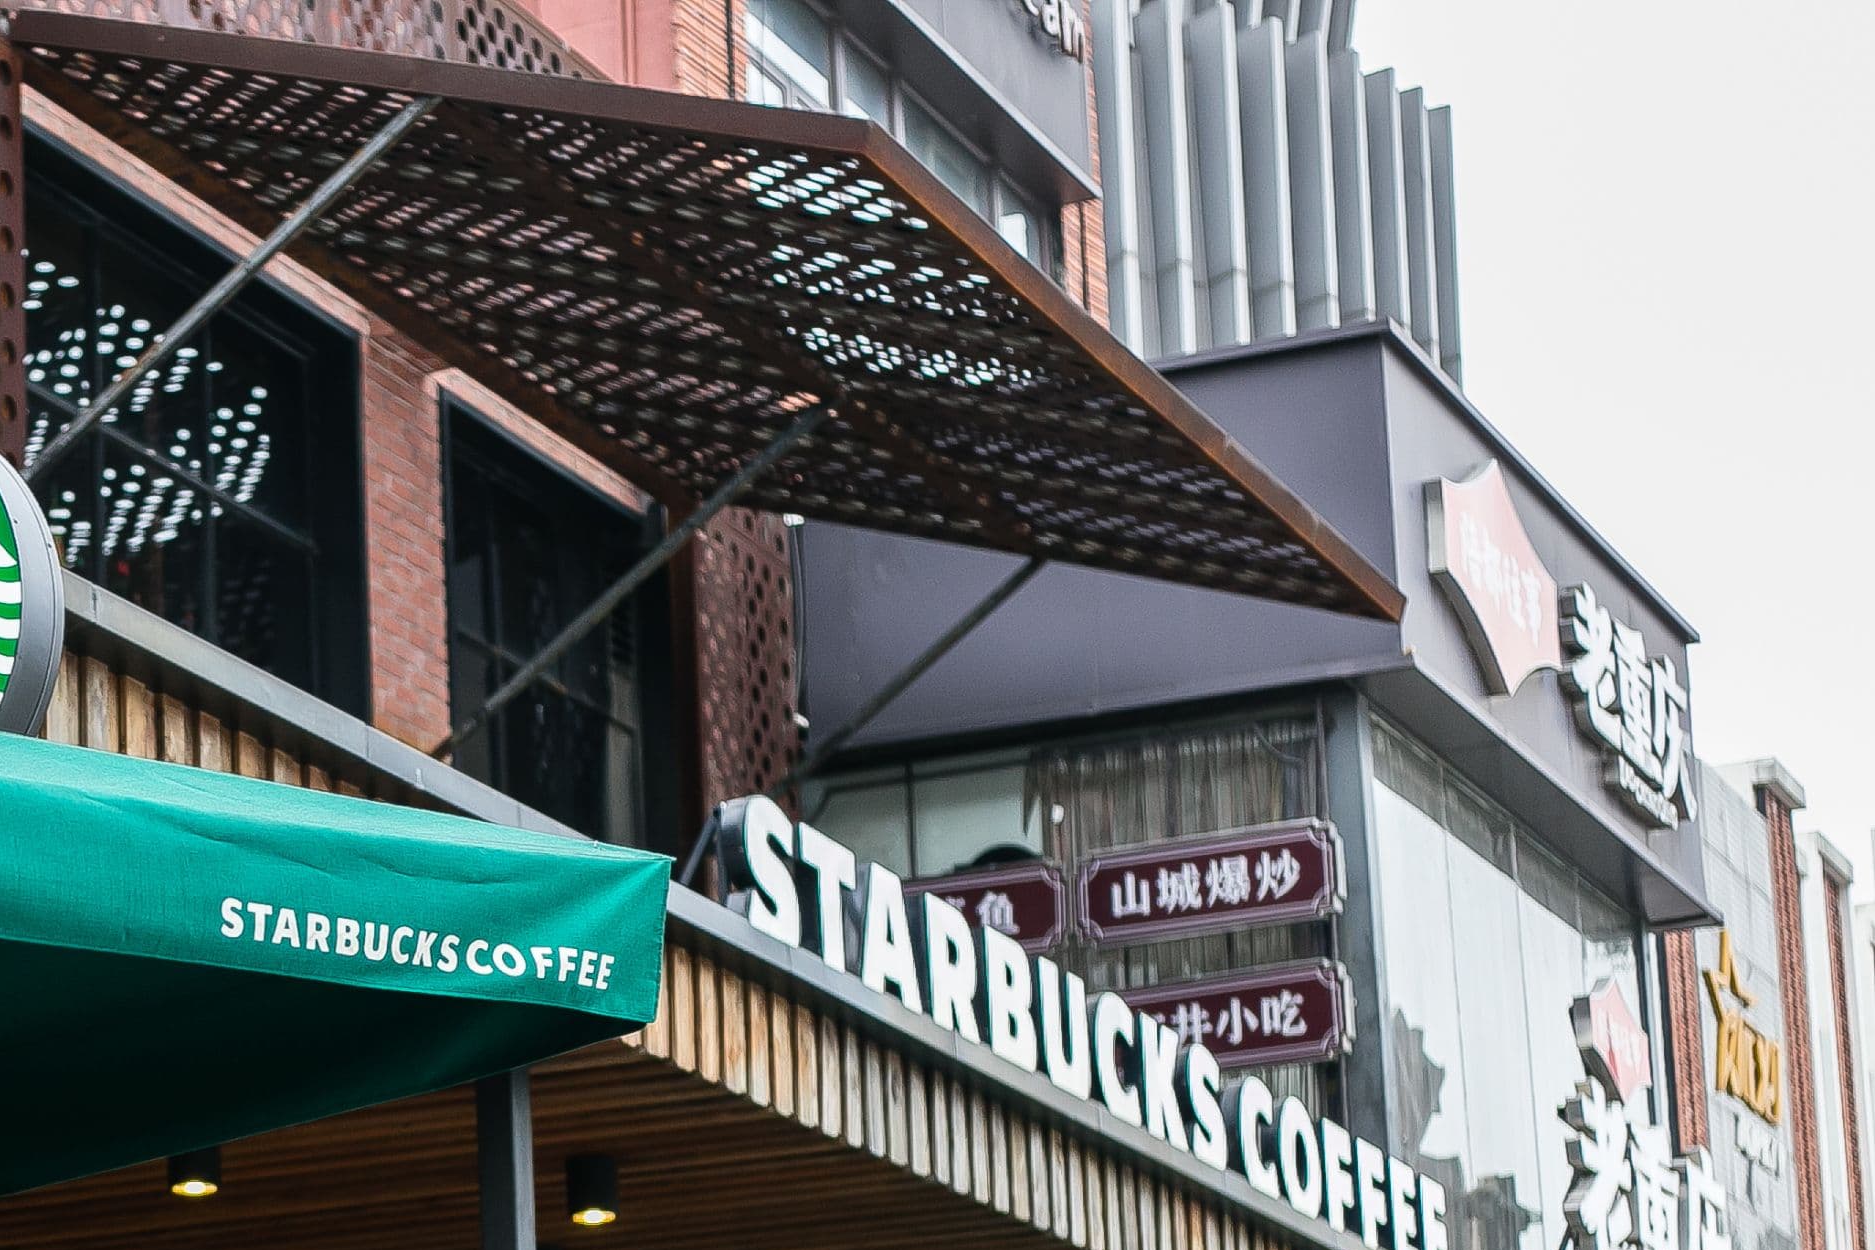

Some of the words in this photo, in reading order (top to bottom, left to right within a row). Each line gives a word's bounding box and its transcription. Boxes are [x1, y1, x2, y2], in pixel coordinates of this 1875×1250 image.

[1109, 847, 1302, 920] 山城爆炒
[220, 896, 460, 974] STARBUCKS
[465, 936, 616, 991] COFFEE
[742, 794, 1229, 1173] STARBUCKS
[1156, 988, 1308, 1046] 井小吃
